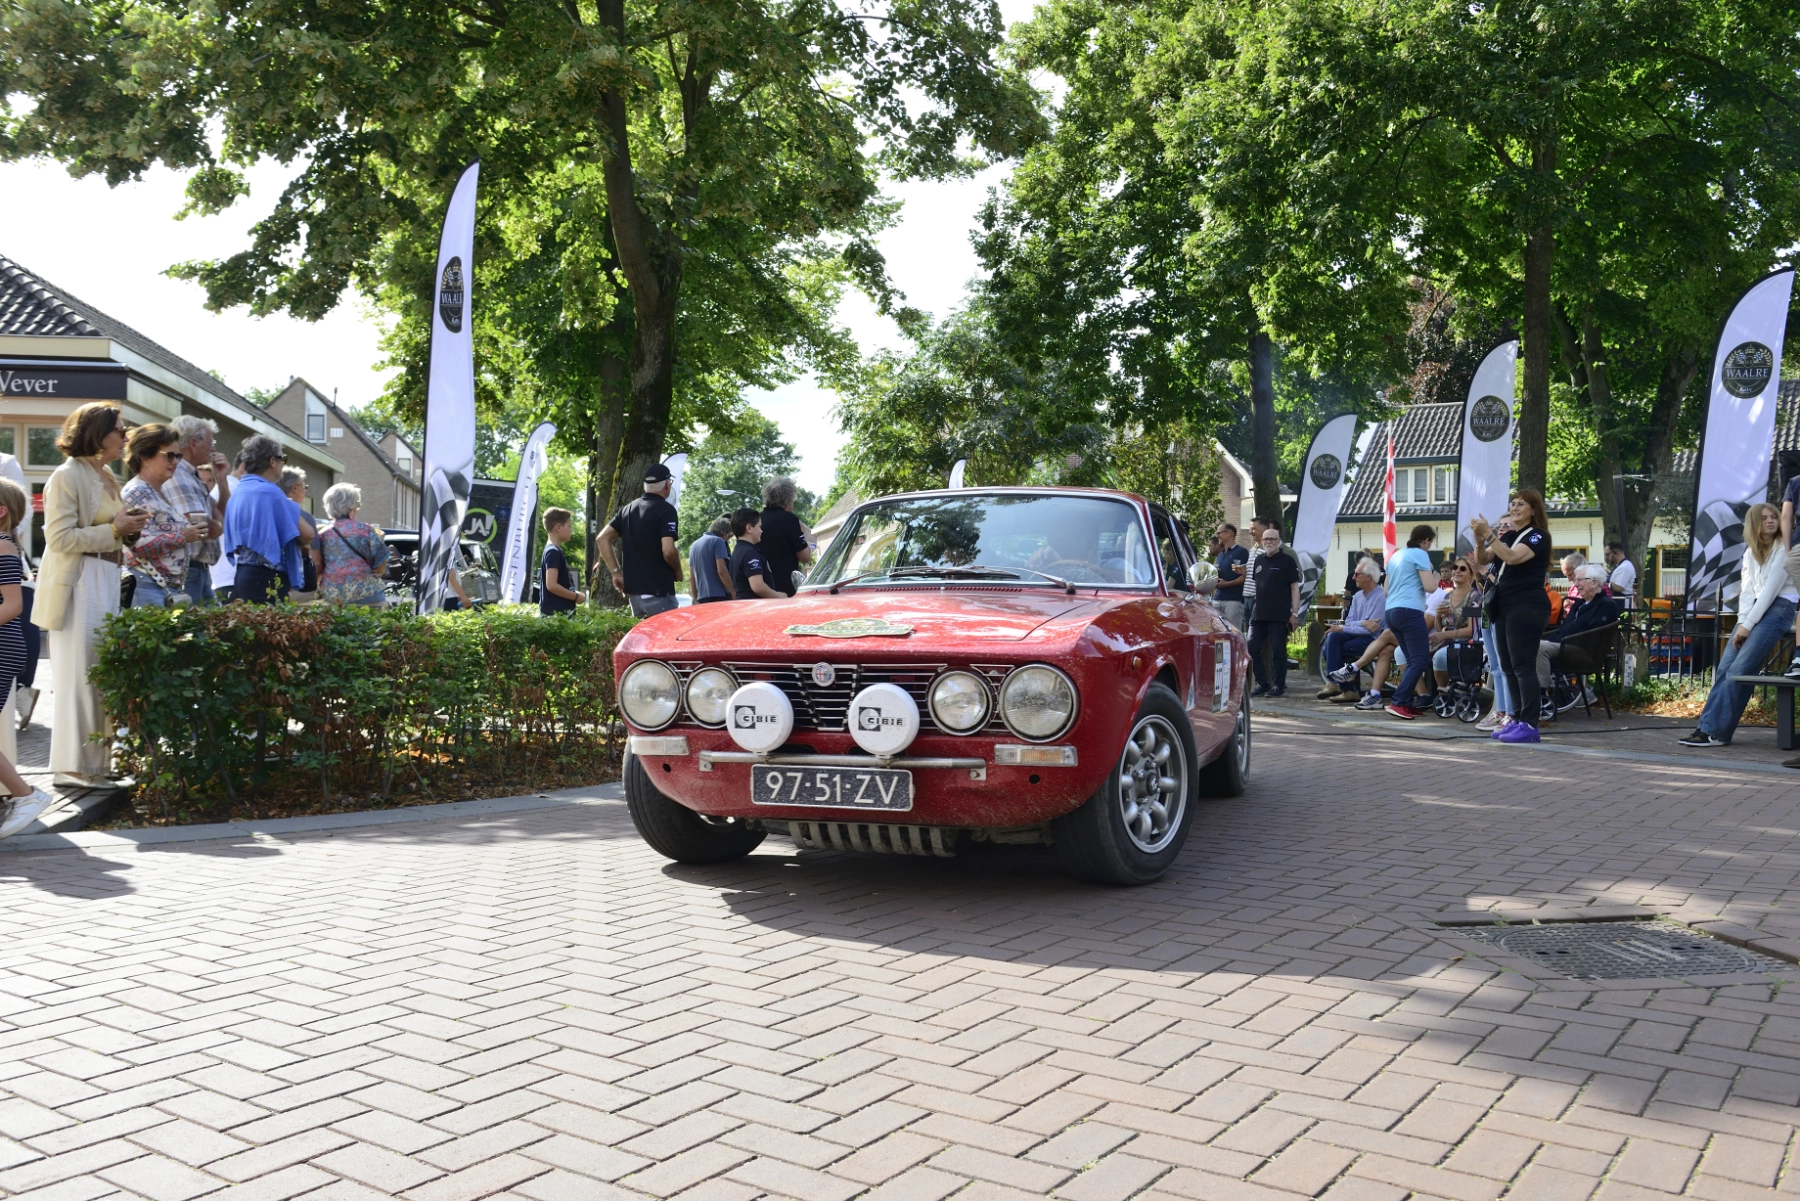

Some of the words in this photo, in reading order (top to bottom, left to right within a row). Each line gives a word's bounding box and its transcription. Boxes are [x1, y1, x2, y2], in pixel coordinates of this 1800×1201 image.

[1726, 368, 1769, 378] WAALRE
[1473, 417, 1506, 425] WAALRE
[1313, 468, 1339, 479] WAALRE
[464, 514, 495, 537] JA!
[743, 715, 777, 723] CIBIE
[867, 717, 904, 726] CIBIE
[766, 771, 899, 805] 97-51-ZV
